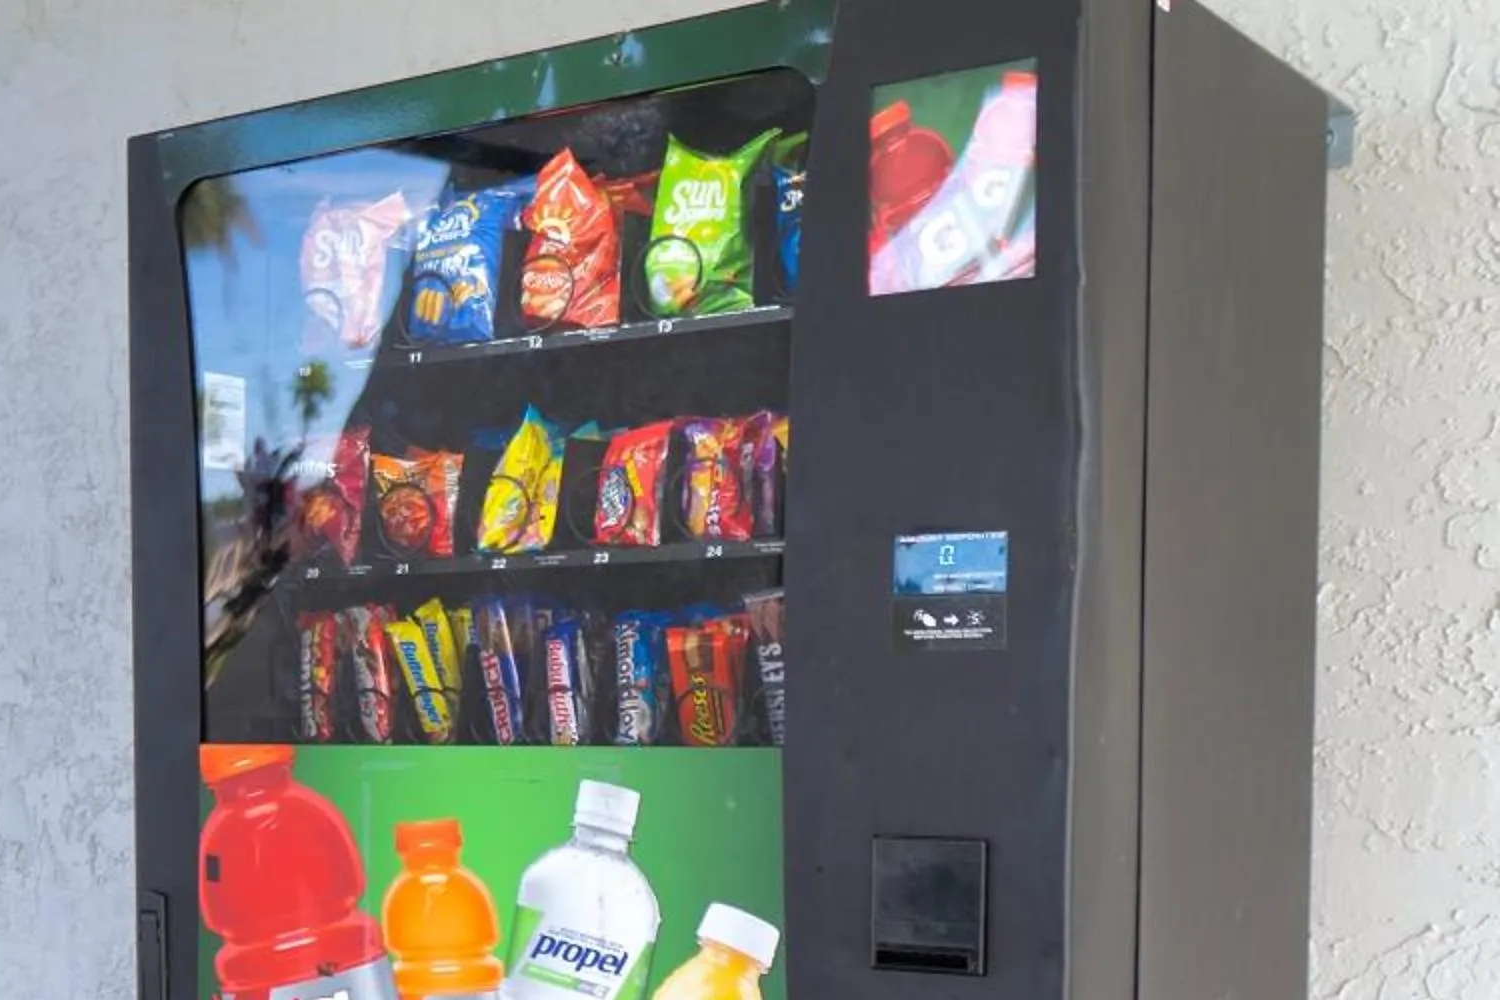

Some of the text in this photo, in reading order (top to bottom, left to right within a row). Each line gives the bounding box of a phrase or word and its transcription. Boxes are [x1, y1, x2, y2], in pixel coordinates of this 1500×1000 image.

[705, 545, 723, 558] 24
[491, 558, 507, 569] 22
[593, 552, 609, 564] 23
[396, 563, 410, 575] 21
[690, 674, 717, 746] Reeses
[530, 933, 629, 976] propel
